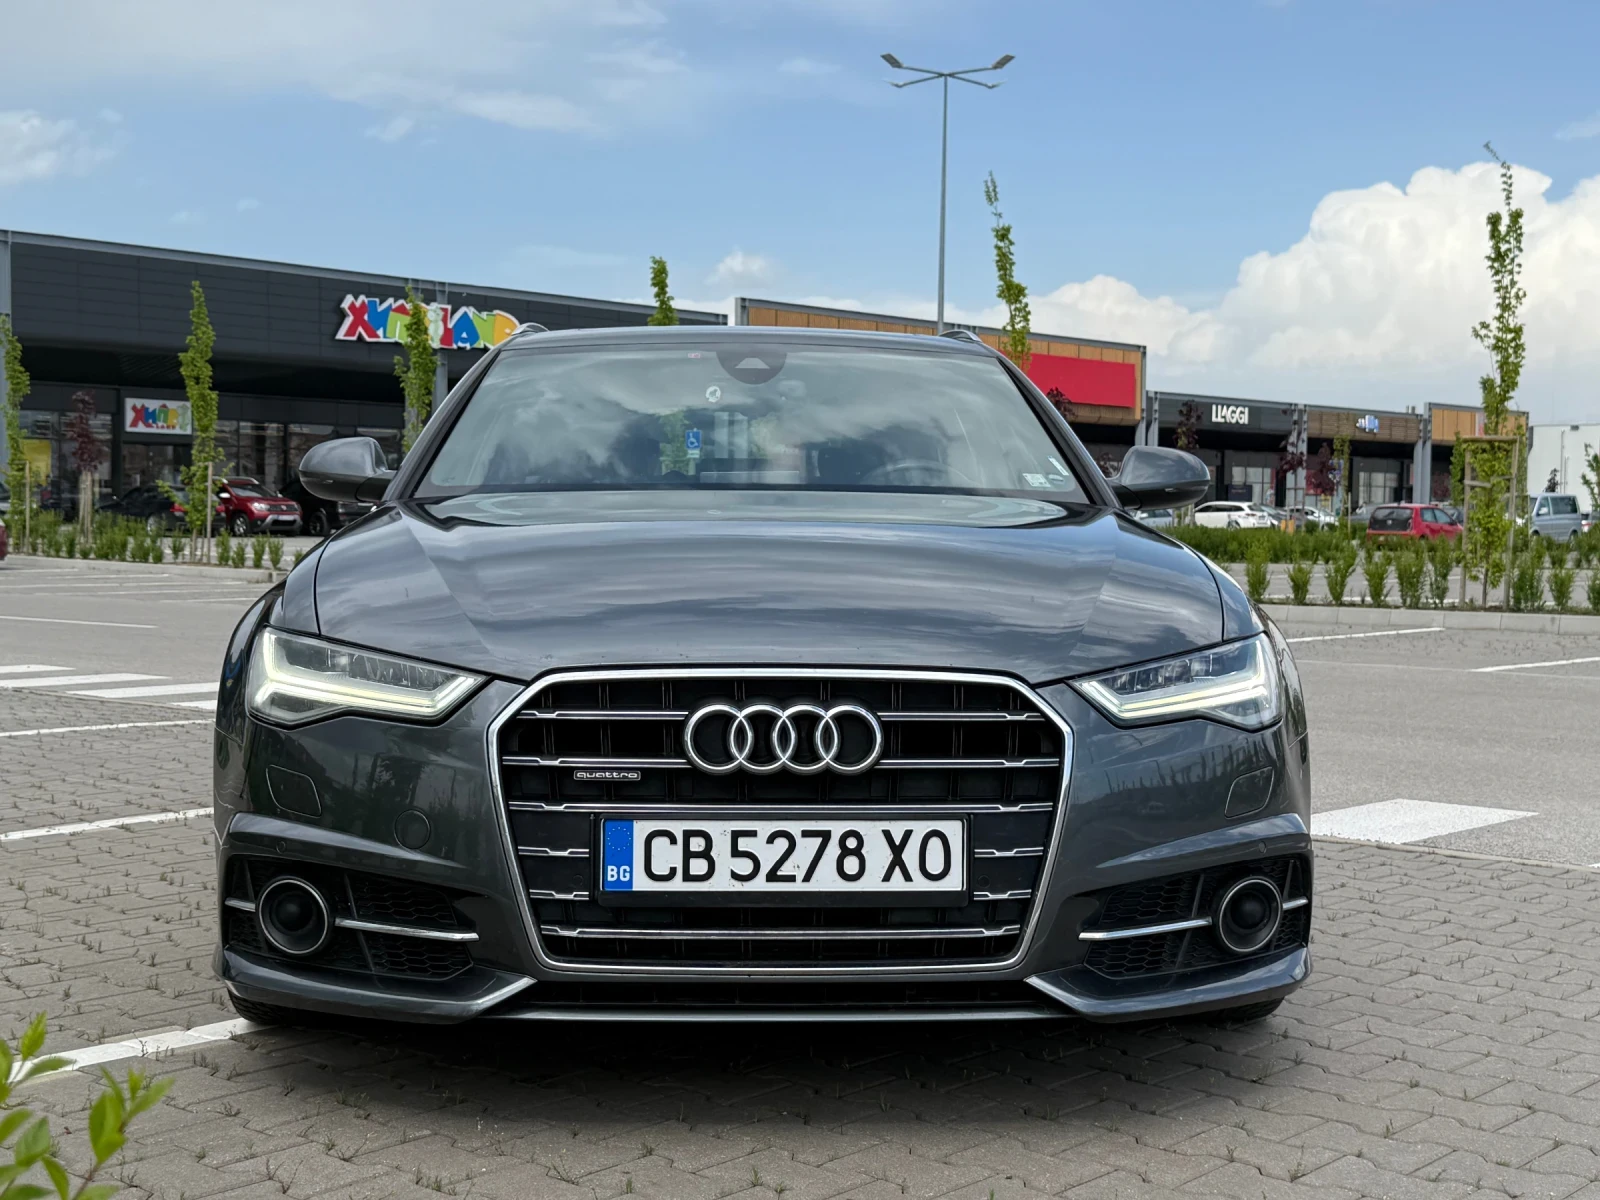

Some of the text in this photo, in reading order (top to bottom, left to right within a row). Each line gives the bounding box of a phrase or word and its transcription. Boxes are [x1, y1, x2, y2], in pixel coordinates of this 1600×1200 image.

[576, 771, 638, 779] quattro
[643, 829, 716, 882] CB
[729, 829, 867, 882] 5278
[607, 865, 631, 882] BG
